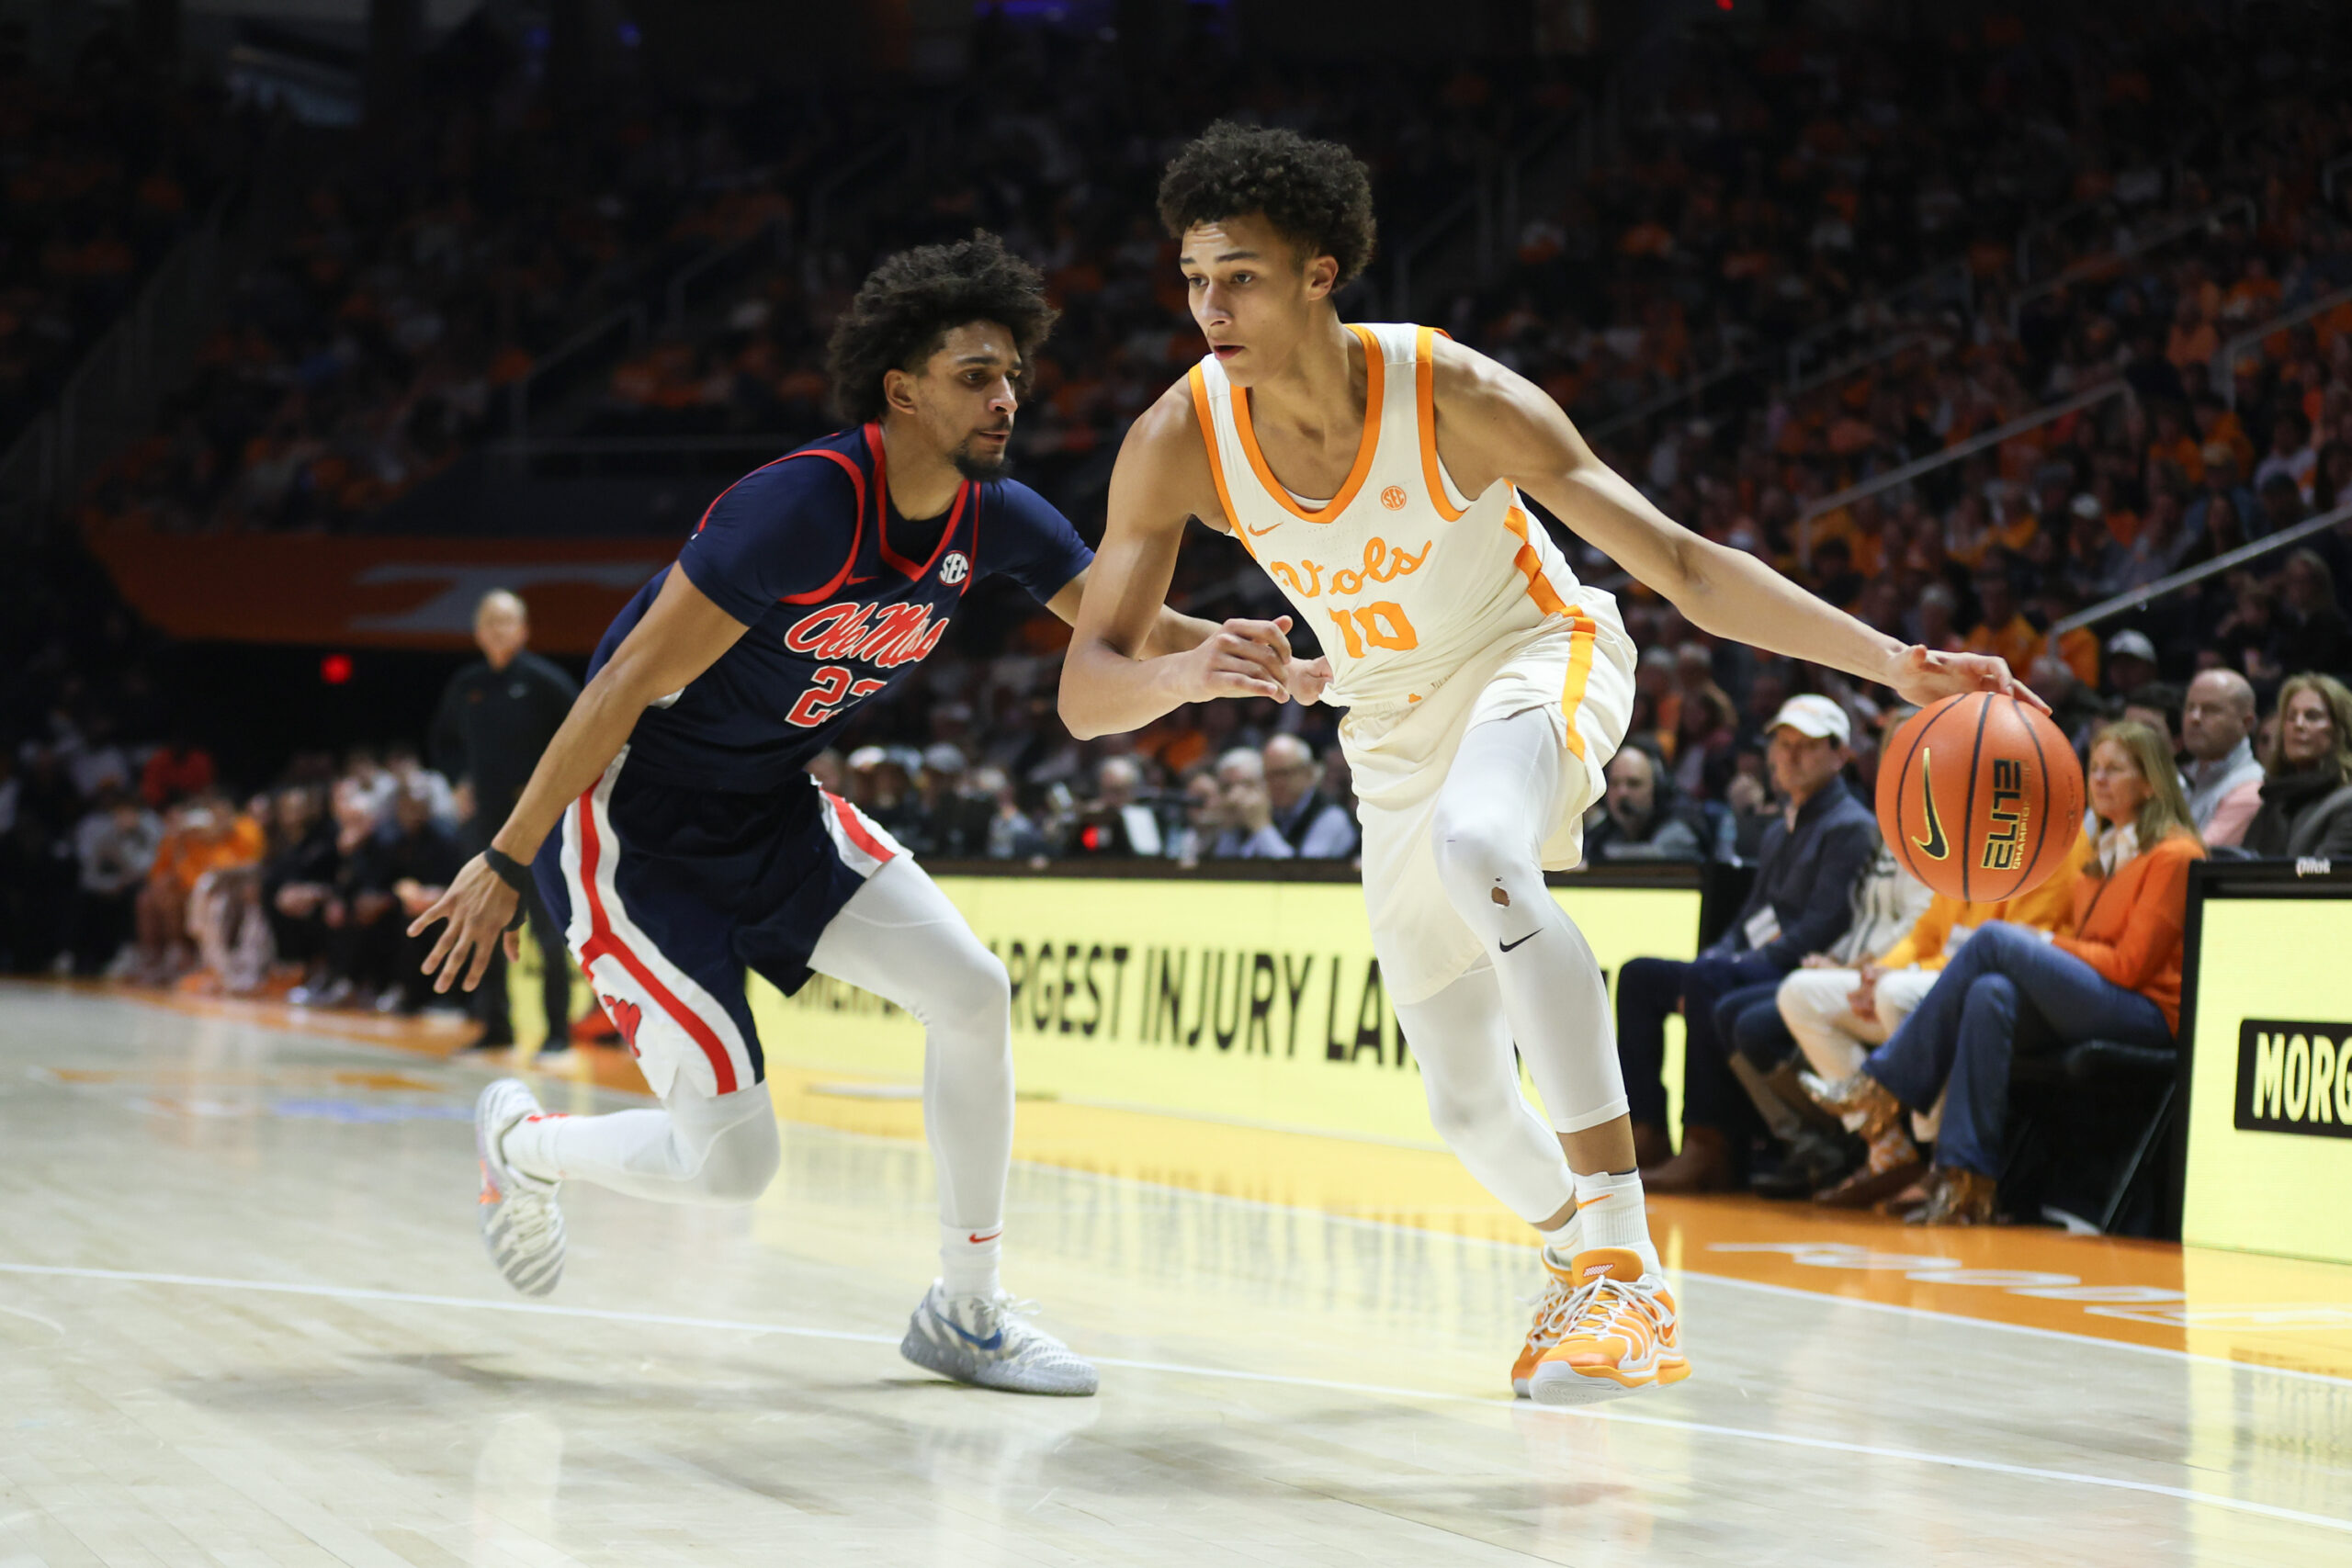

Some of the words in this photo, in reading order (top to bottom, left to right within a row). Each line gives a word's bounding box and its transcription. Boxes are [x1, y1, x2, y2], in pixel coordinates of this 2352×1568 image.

[1384, 488, 1405, 509] SEC
[939, 552, 969, 584] SEC
[1270, 536, 1431, 598] Vols
[1328, 601, 1419, 659] 10
[1980, 758, 2021, 870] ELITE
[989, 941, 1129, 1039] RGEST
[1140, 948, 1313, 1057] INJURY
[2253, 1032, 2352, 1126] MORG
